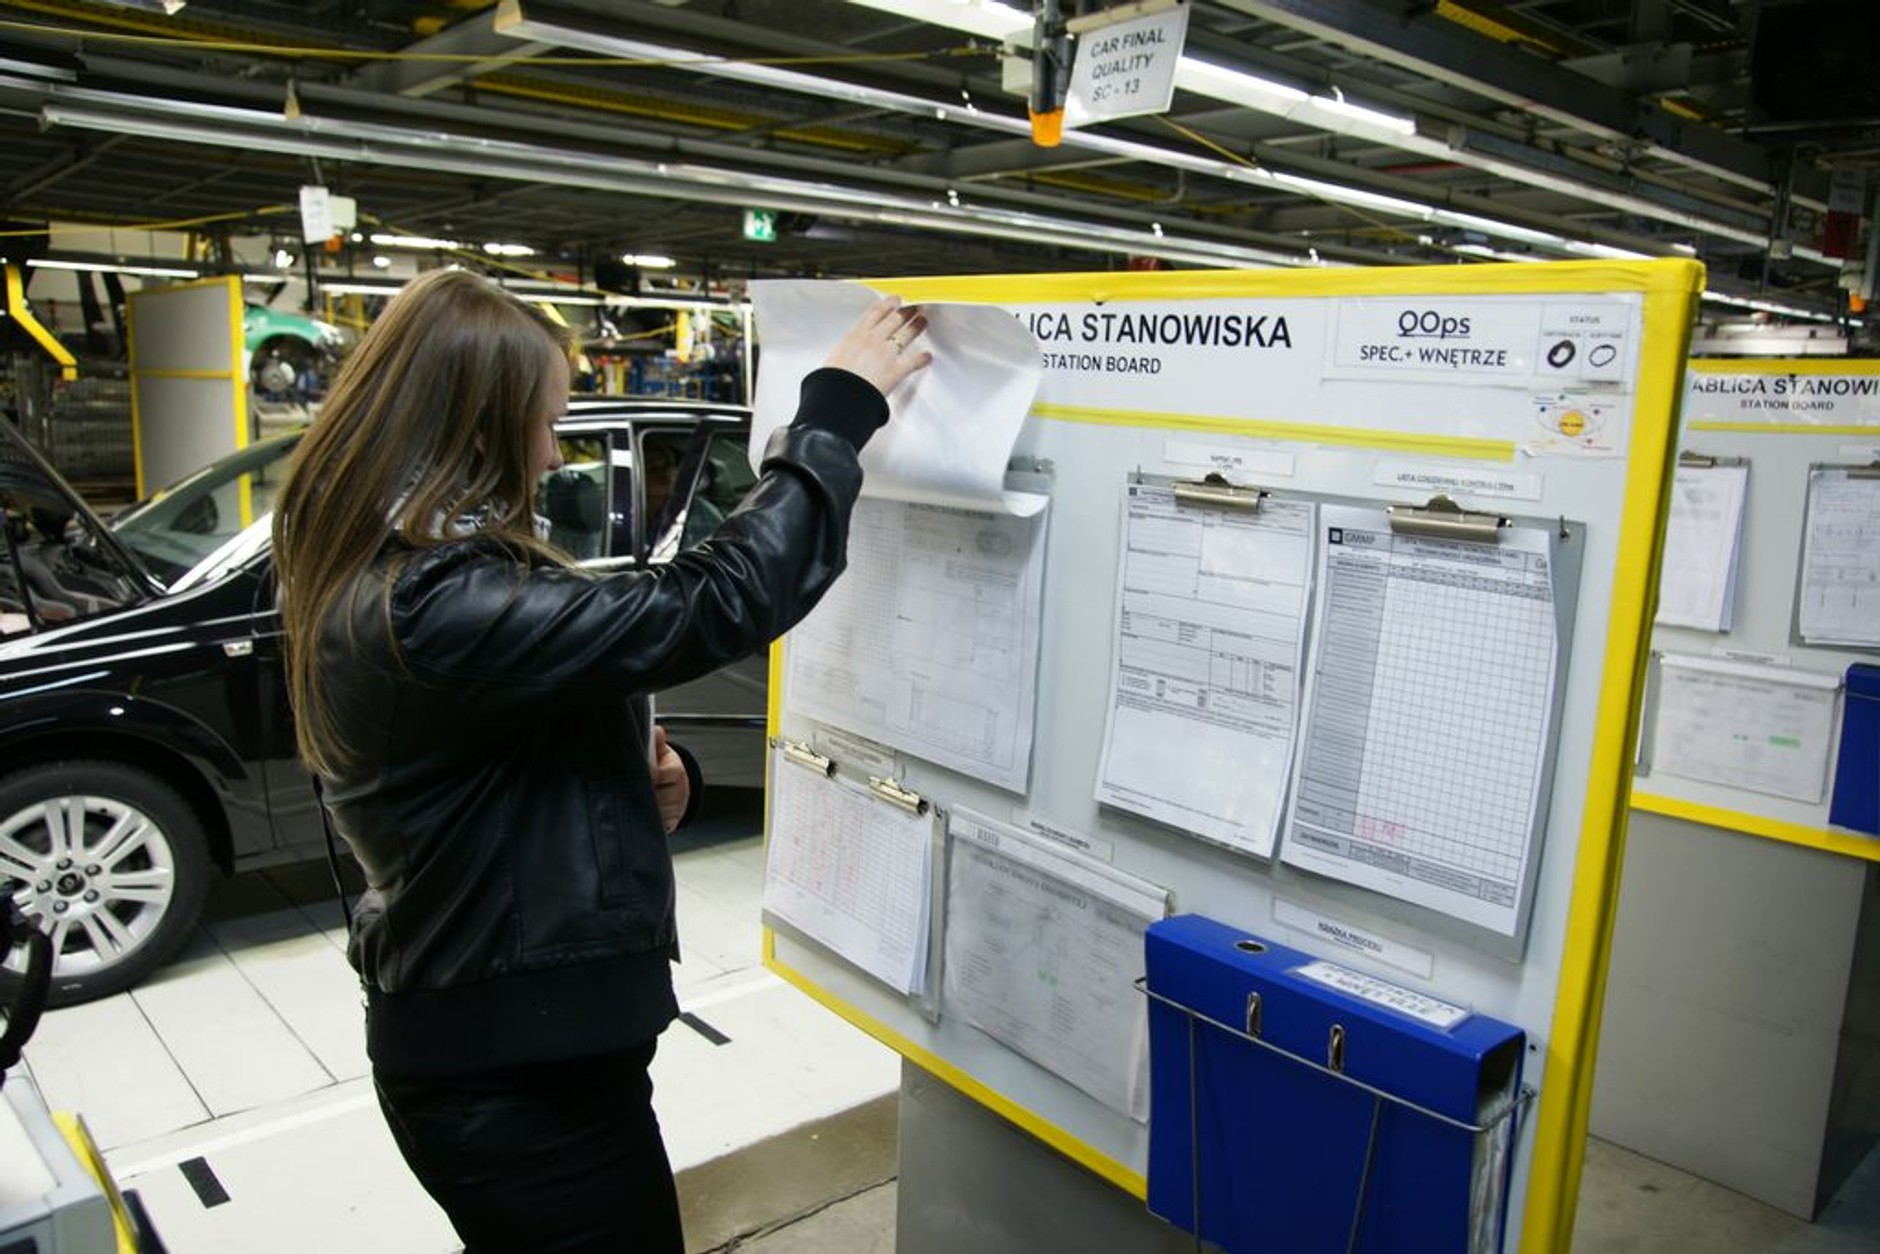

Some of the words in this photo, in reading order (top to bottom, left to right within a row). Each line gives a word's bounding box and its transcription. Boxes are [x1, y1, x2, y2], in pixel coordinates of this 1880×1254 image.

[1090, 37, 1119, 58] CAR
[1123, 28, 1166, 47] FINAL
[1091, 53, 1154, 79] QUALITY
[1092, 83, 1110, 101] SC
[1124, 78, 1140, 94] 13
[1015, 312, 1073, 341] ICA
[1082, 313, 1292, 348] STANOWISKA
[1043, 353, 1101, 371] STATION
[1106, 356, 1161, 374] BOARD
[1419, 347, 1508, 368] WNĘTRZE
[1773, 378, 1880, 396] STANOWI
[1740, 400, 1789, 410] STATION
